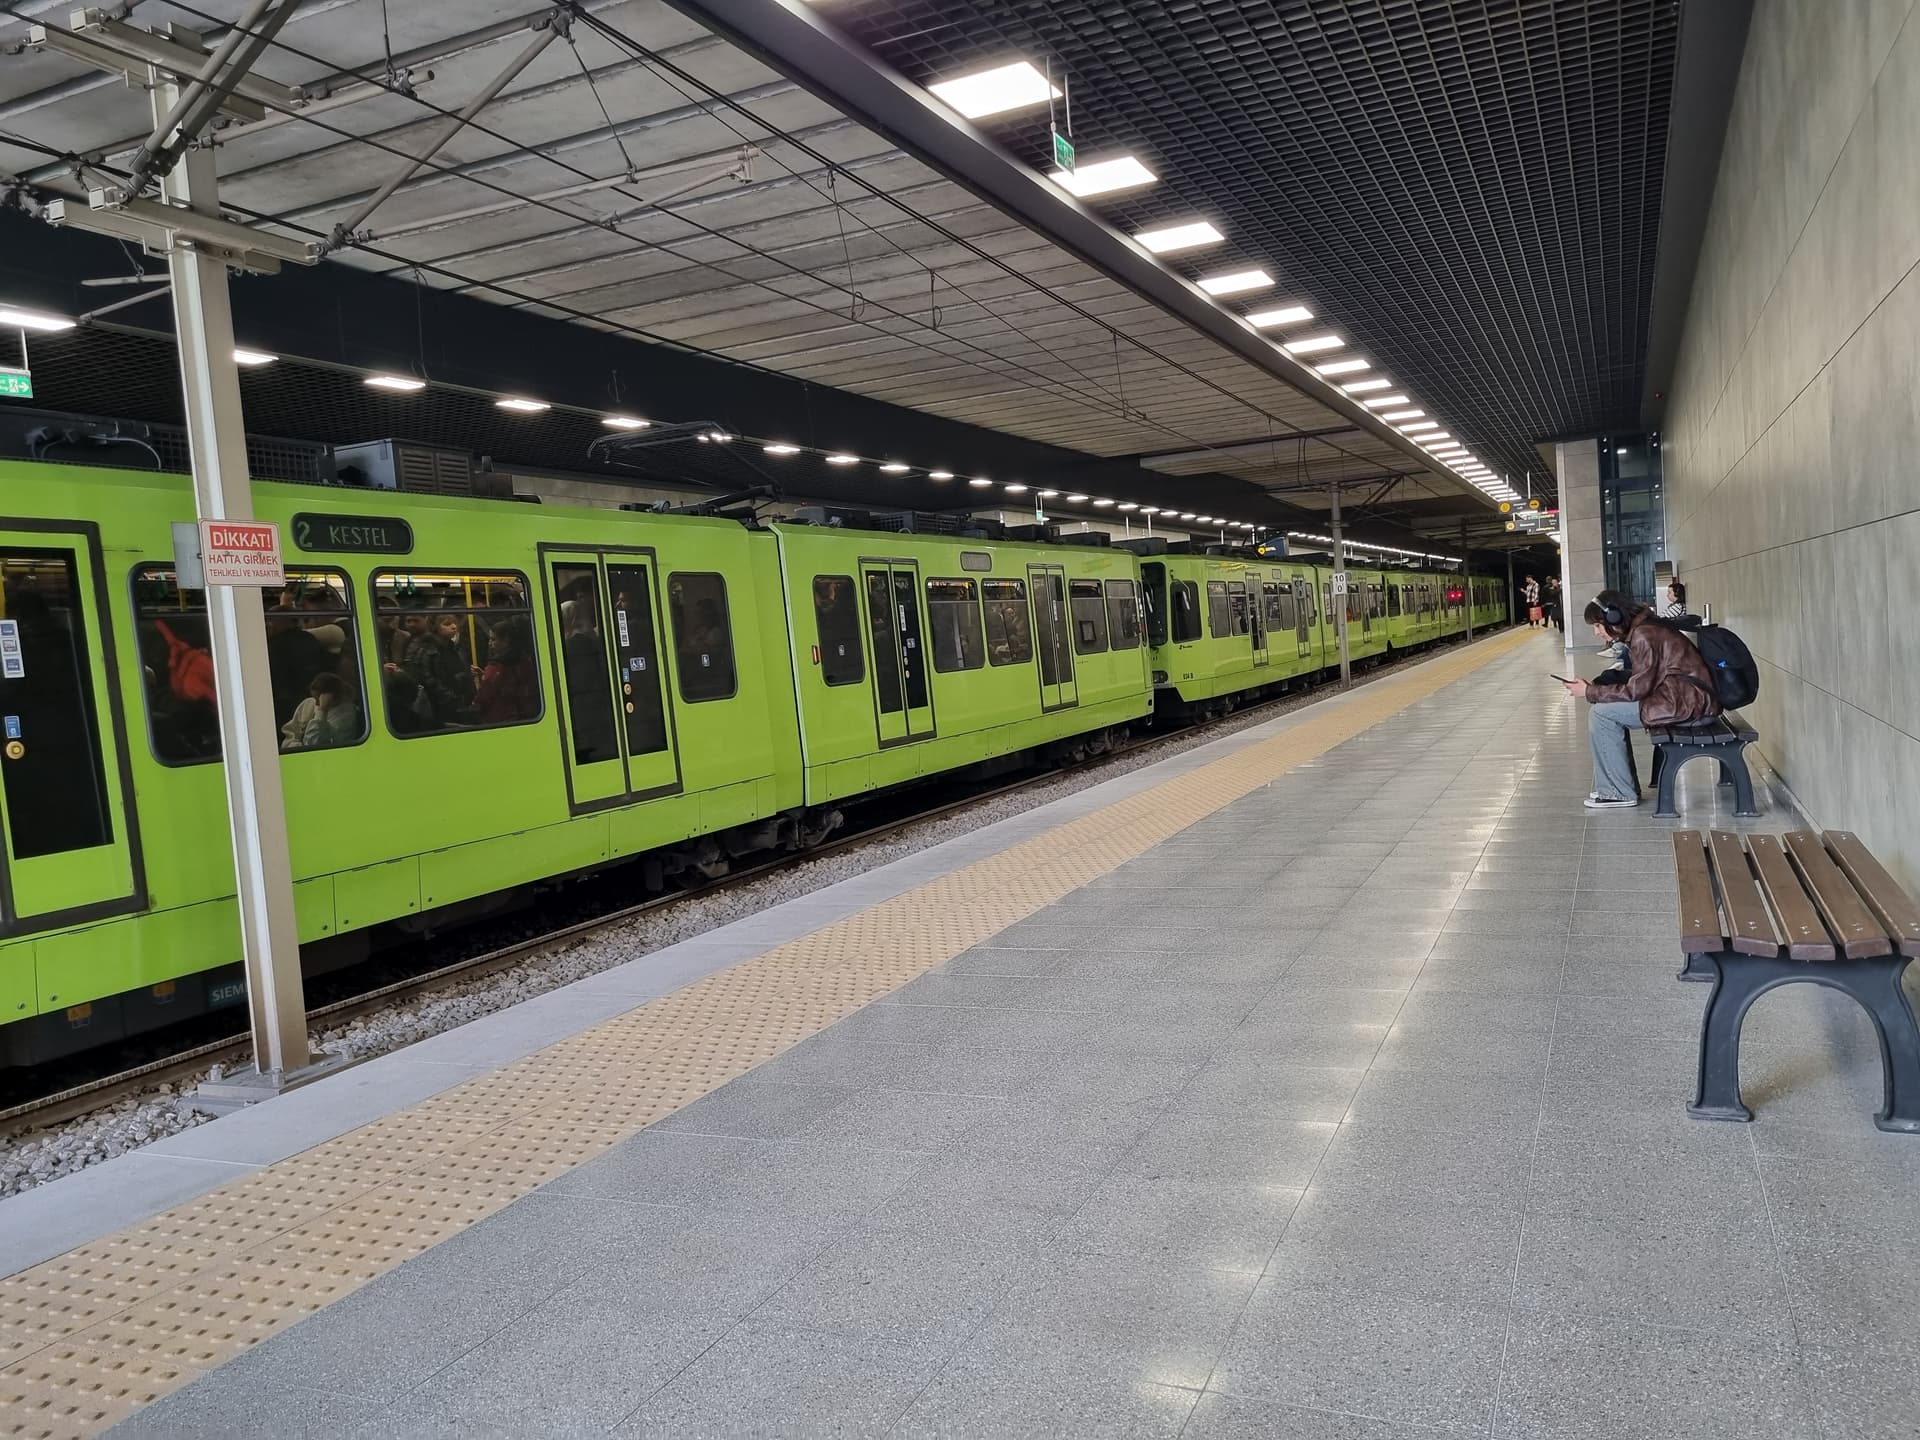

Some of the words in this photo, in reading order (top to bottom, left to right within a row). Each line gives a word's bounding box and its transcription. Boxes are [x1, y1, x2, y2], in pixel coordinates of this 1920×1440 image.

[212, 528, 271, 548] DİKKAT!
[297, 521, 312, 548] 2
[329, 525, 391, 547] KESTEL
[209, 554, 242, 565] HATTA
[243, 553, 279, 566] GİRMEK
[209, 568, 242, 577] TEHLİKELİ
[242, 569, 251, 577] VE
[1334, 574, 1344, 583] 10
